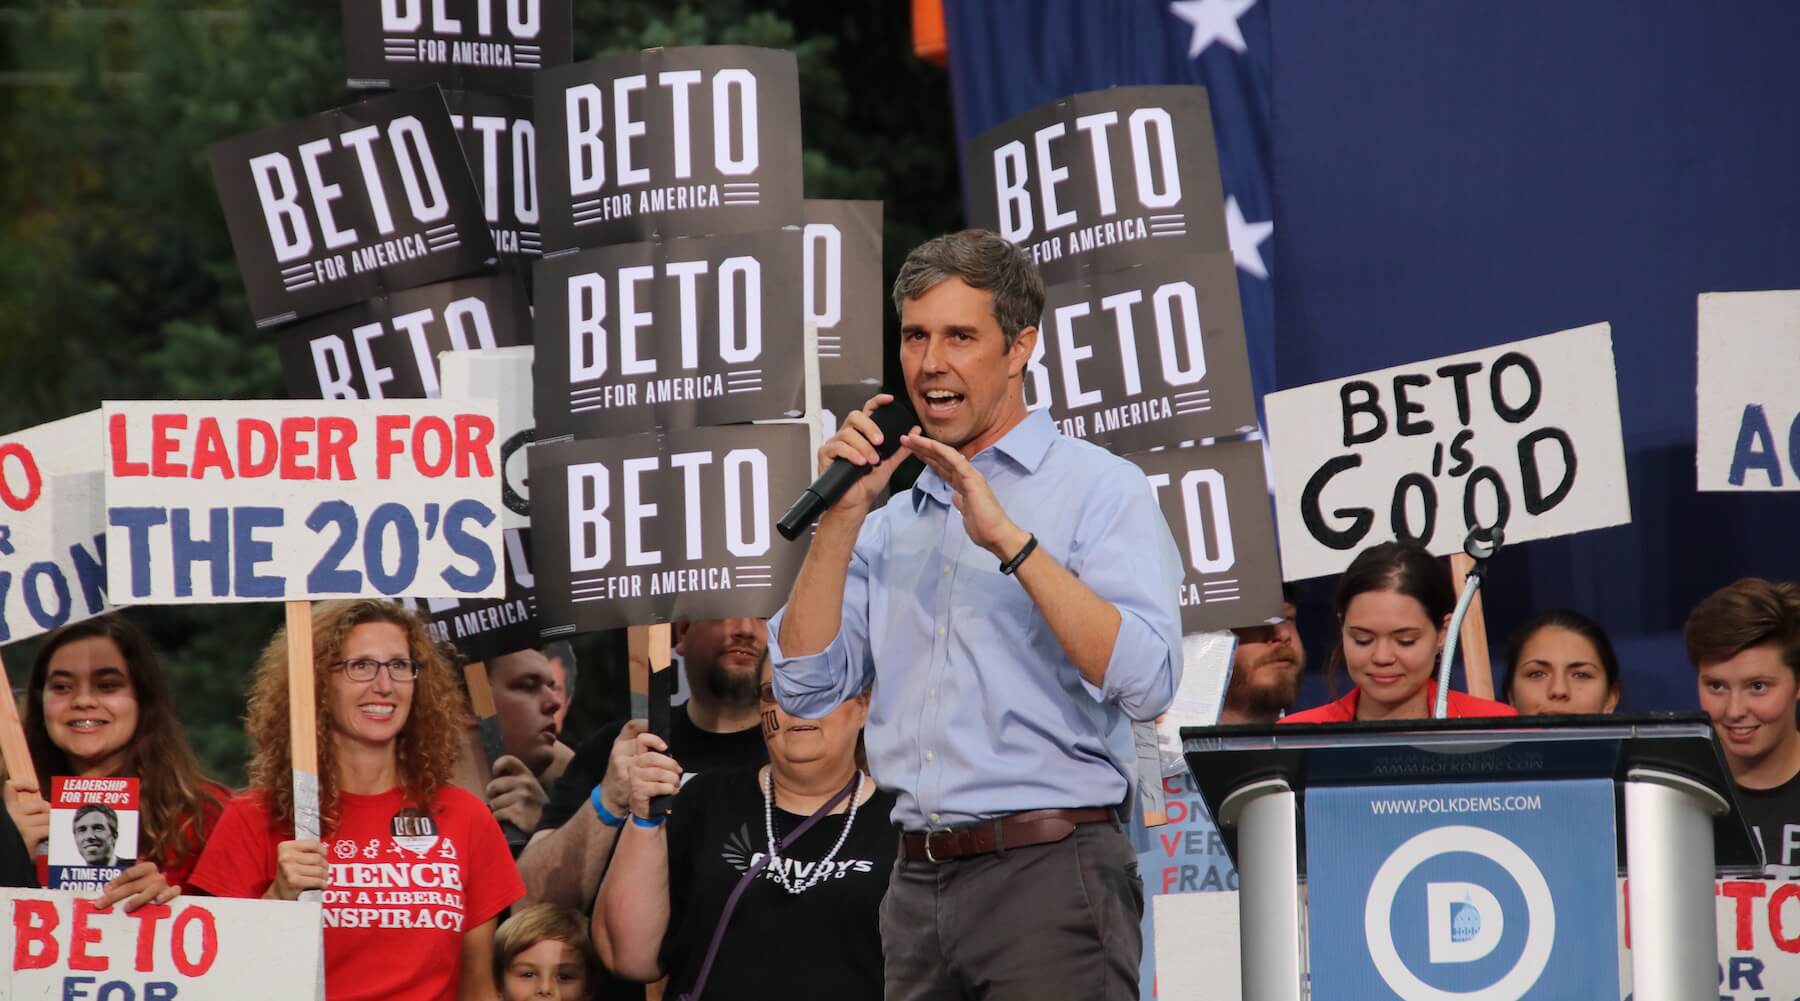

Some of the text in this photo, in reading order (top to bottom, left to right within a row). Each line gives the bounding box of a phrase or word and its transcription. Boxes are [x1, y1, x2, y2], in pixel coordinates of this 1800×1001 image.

[418, 40, 512, 66] FOR AMERICA
[566, 69, 759, 196] BETO
[249, 115, 449, 263] BETO
[450, 115, 540, 224] TO
[994, 107, 1182, 244] BETO
[603, 184, 719, 220] FOR AMERICA
[315, 233, 428, 284] FOR AMERICA
[1032, 217, 1147, 265] FOR AMERICA
[568, 256, 762, 383] BETO
[604, 373, 723, 408] FOR AMERICA
[1340, 351, 1542, 447] BETO
[1094, 396, 1173, 434] AMERICA
[109, 413, 358, 480] LEADER
[376, 414, 495, 479] FOR
[1432, 428, 1474, 477] IS
[568, 449, 771, 572] BETO
[1300, 427, 1578, 549] GOOD
[108, 506, 287, 598] THE
[305, 499, 497, 595] 20'S
[608, 567, 731, 599] FOR AMERICA
[454, 600, 528, 638] AMERICA
[60, 791, 130, 804] FOR THE 20'S
[63, 779, 128, 792] LEADERSHIP
[1371, 795, 1542, 815] WWW.POLKDEMS.COM
[60, 868, 121, 881] A TIME FOR
[321, 890, 464, 910] OT A LIBERAL
[321, 907, 464, 933] NSPIRACY
[12, 897, 218, 978] BETO
